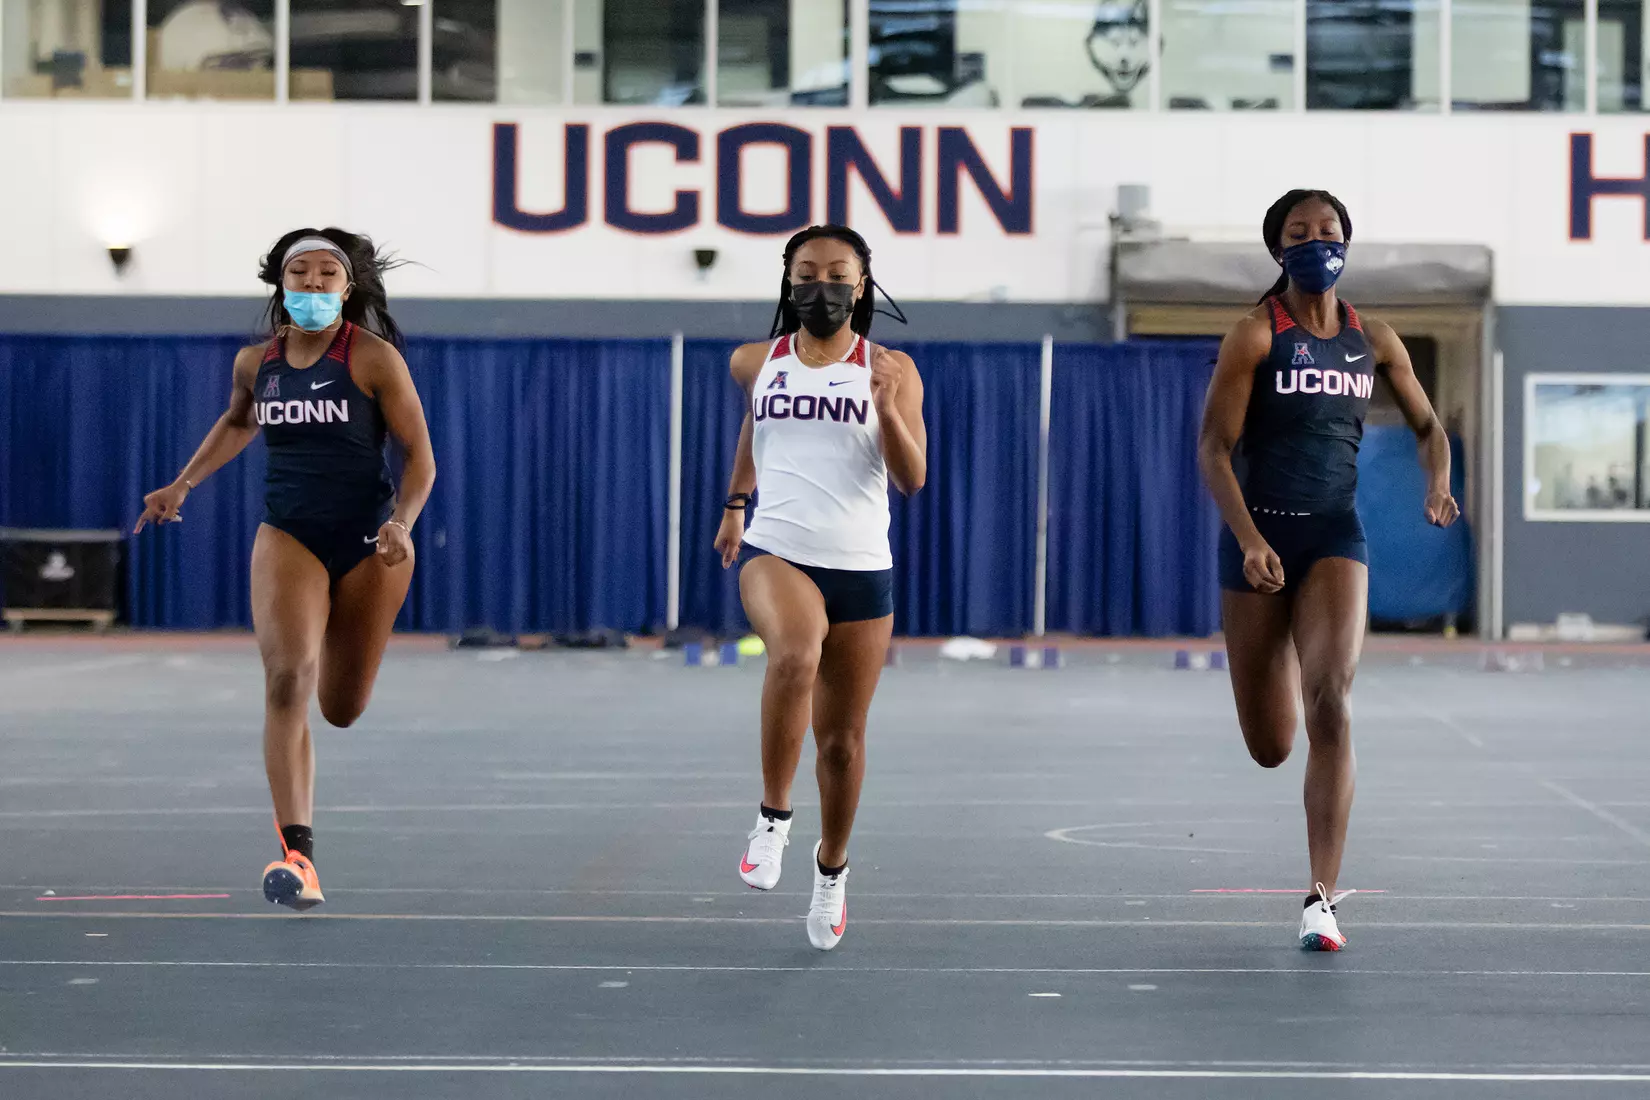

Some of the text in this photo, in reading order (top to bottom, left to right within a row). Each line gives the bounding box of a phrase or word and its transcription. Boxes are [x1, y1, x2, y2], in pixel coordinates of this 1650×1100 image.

[491, 121, 1036, 236] UCONN
[1275, 367, 1374, 399] UCONN
[255, 399, 349, 426] UCONN
[754, 393, 869, 425] UCONN
